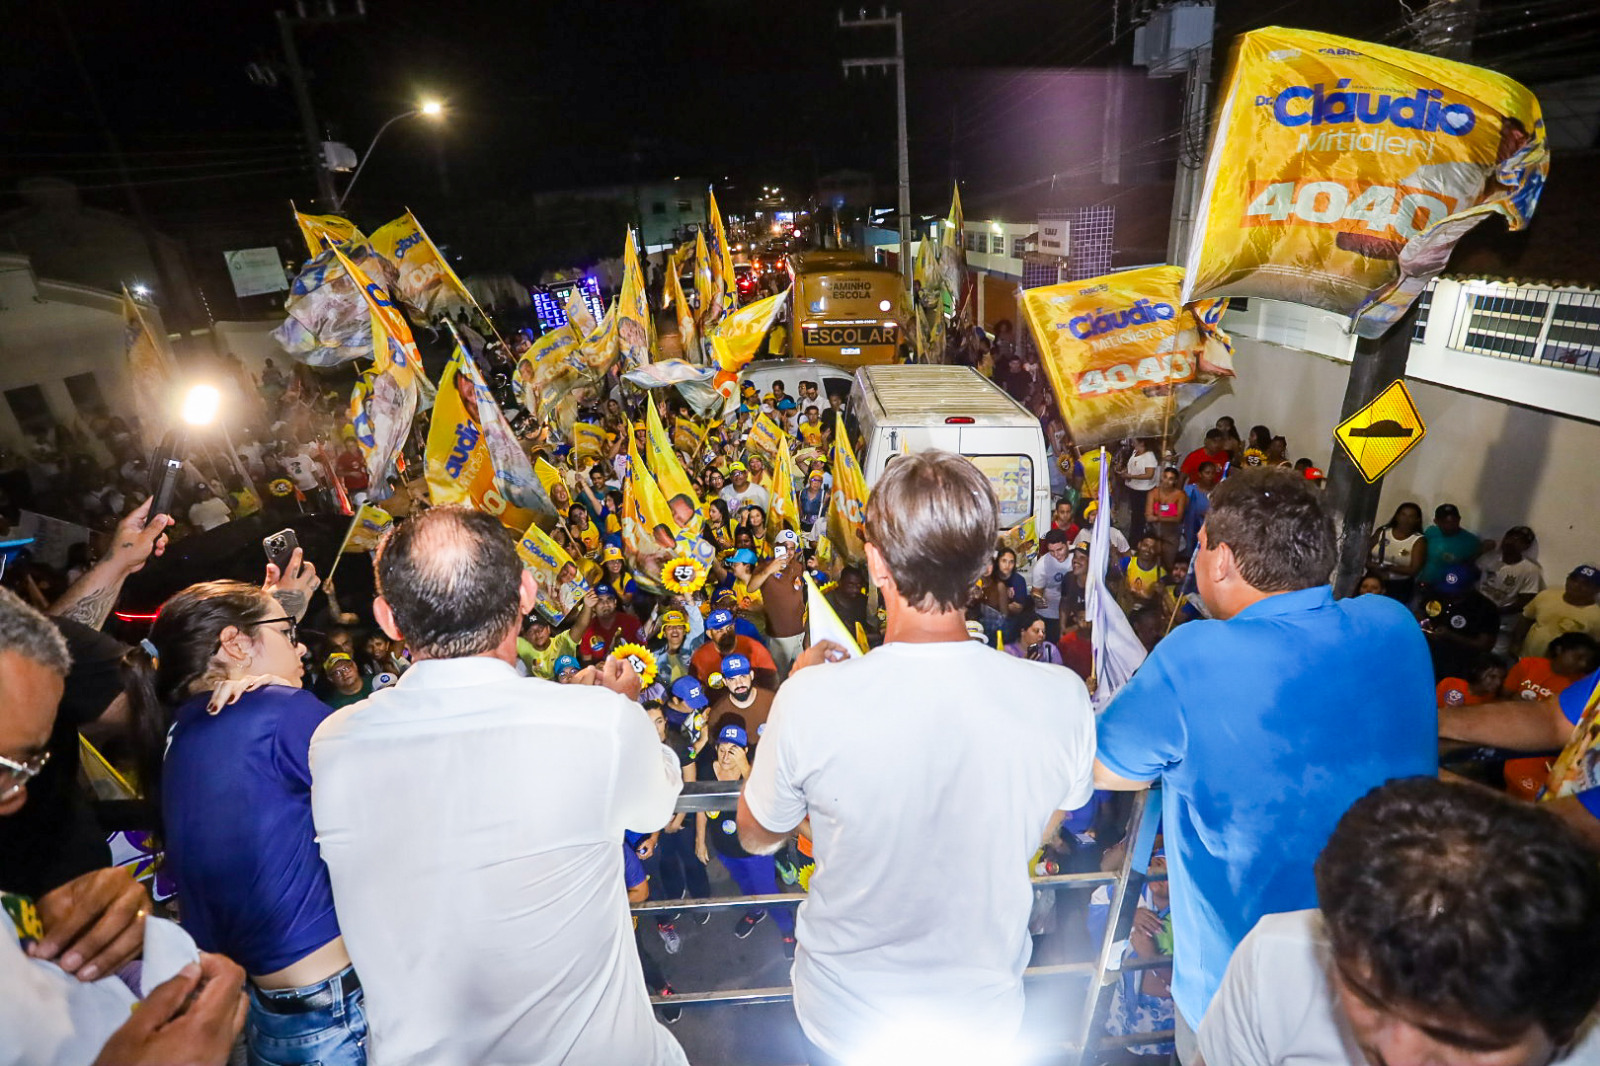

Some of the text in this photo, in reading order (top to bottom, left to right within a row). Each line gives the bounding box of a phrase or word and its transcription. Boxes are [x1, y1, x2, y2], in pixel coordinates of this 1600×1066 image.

[1255, 78, 1476, 136] Dr. Cláudio
[1246, 181, 1451, 240] 4040
[832, 291, 871, 299] ESCOLA
[1069, 298, 1176, 340] Cláudio
[807, 329, 895, 344] ESCOLAR
[1078, 352, 1192, 393] 4040
[674, 566, 694, 576] 55
[1581, 567, 1595, 577] 55
[716, 612, 727, 623] 55
[729, 659, 741, 669] 55
[690, 687, 700, 698] 55
[726, 728, 738, 738] 55
